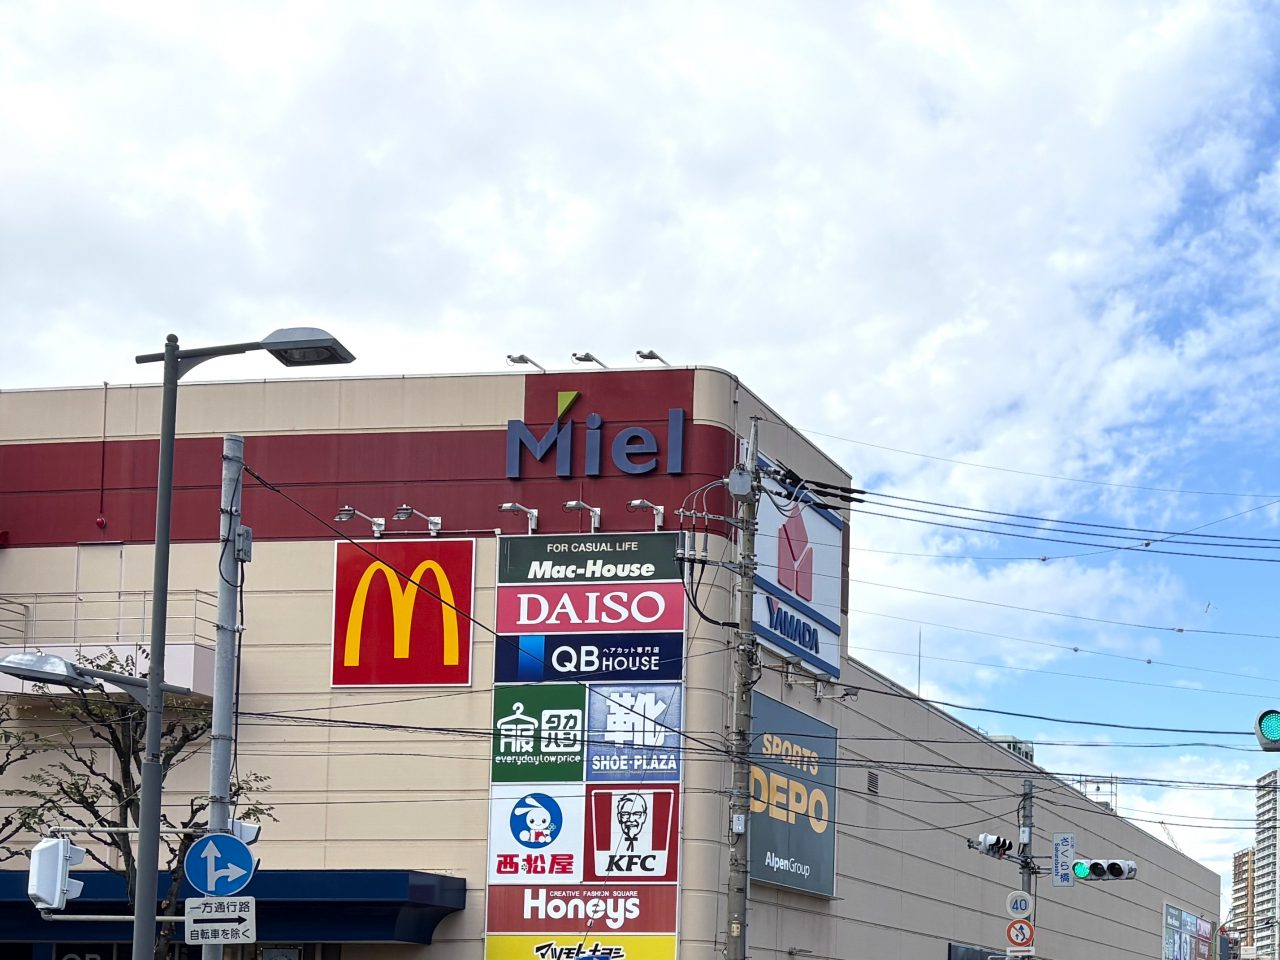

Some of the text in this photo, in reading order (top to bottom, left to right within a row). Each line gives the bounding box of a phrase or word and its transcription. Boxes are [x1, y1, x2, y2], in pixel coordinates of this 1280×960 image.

[506, 408, 684, 479] Miel
[547, 541, 638, 553] FOR CASUAL LIFE
[527, 560, 656, 579] Mac-House
[516, 591, 666, 625] DAISO
[765, 595, 820, 654] YAMADA
[551, 645, 660, 673] QB HOUSE
[602, 646, 660, 654] ヘアカット専門店
[604, 692, 667, 749] 靴
[762, 733, 819, 776] SPORTS
[750, 765, 829, 834] DEPO
[496, 853, 574, 875] 西松屋
[605, 854, 657, 873] KFC
[190, 901, 250, 914] 一方通行路
[523, 888, 640, 929] Honeys
[1012, 898, 1028, 911] 40
[190, 928, 251, 940] 自転車を除く
